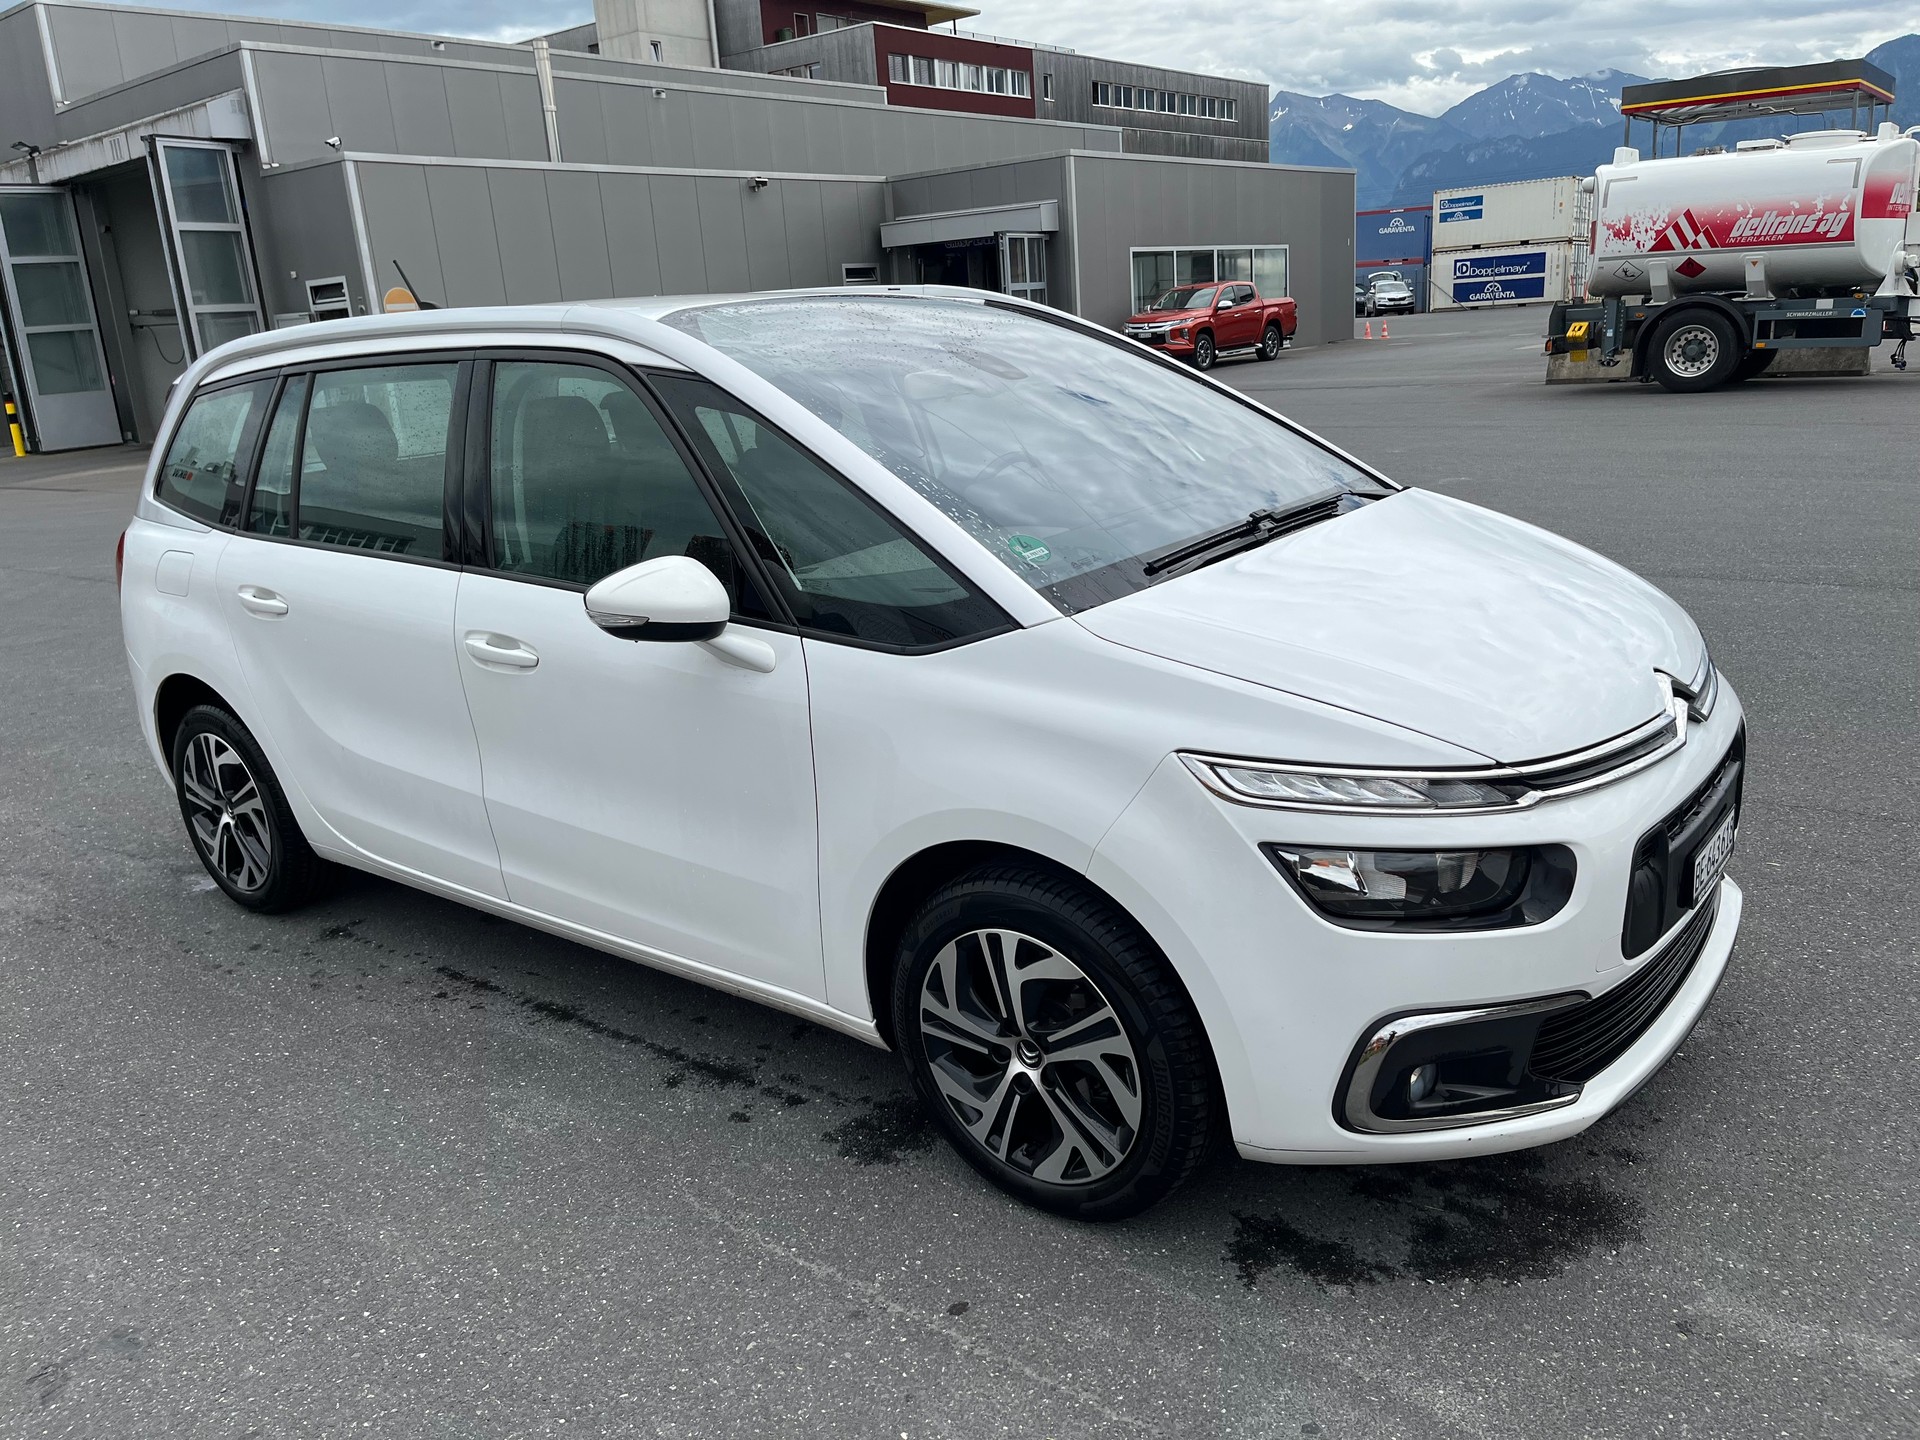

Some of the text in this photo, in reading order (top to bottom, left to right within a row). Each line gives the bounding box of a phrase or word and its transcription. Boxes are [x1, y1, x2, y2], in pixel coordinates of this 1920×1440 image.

[1378, 226, 1415, 234] GARAVENTA
[1725, 234, 1784, 244] INTERLAKEN
[1470, 264, 1528, 276] Doppelmayr
[1469, 290, 1516, 300] GARAVENTA
[895, 960, 910, 1057] BRIDGESTONE
[1149, 1059, 1171, 1168] BRIDGESTONE
